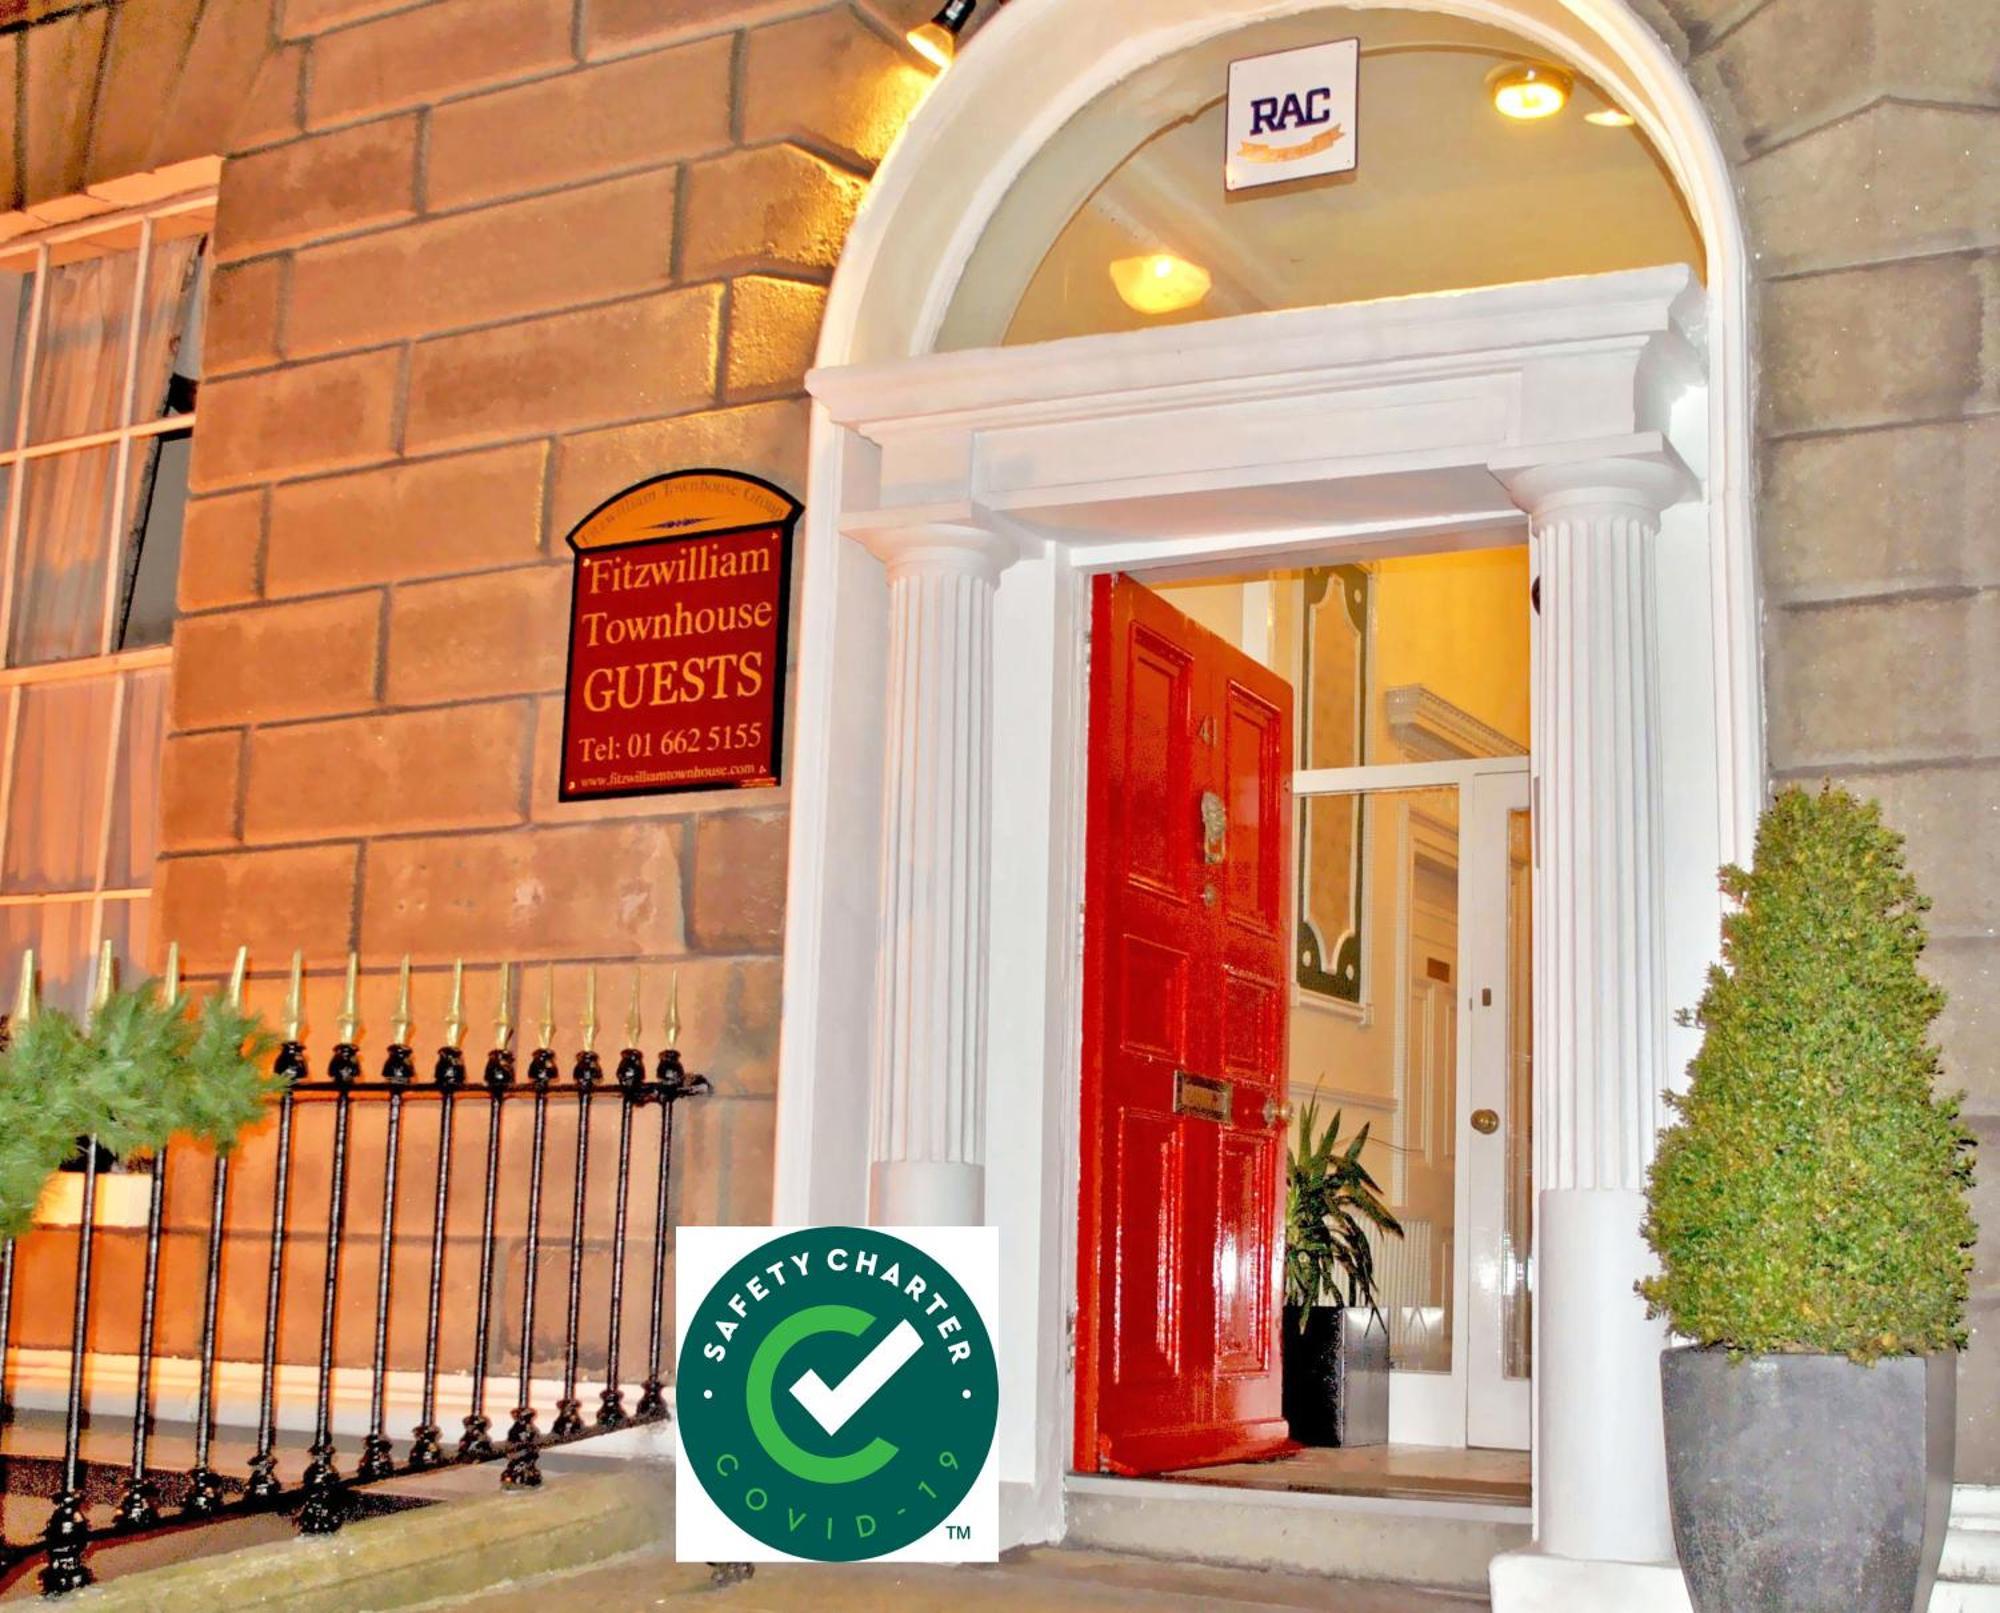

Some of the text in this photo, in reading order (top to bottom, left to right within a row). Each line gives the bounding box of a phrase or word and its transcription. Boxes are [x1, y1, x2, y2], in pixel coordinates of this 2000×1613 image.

[1250, 87, 1331, 136] RAC
[590, 544, 770, 594] Fitzwilliam
[581, 601, 772, 647] Townhouse
[583, 651, 763, 712] GUESTS
[579, 722, 763, 763] Tel: 01 662 5155
[581, 763, 756, 788] www.fitzwilliamtownhouse.com
